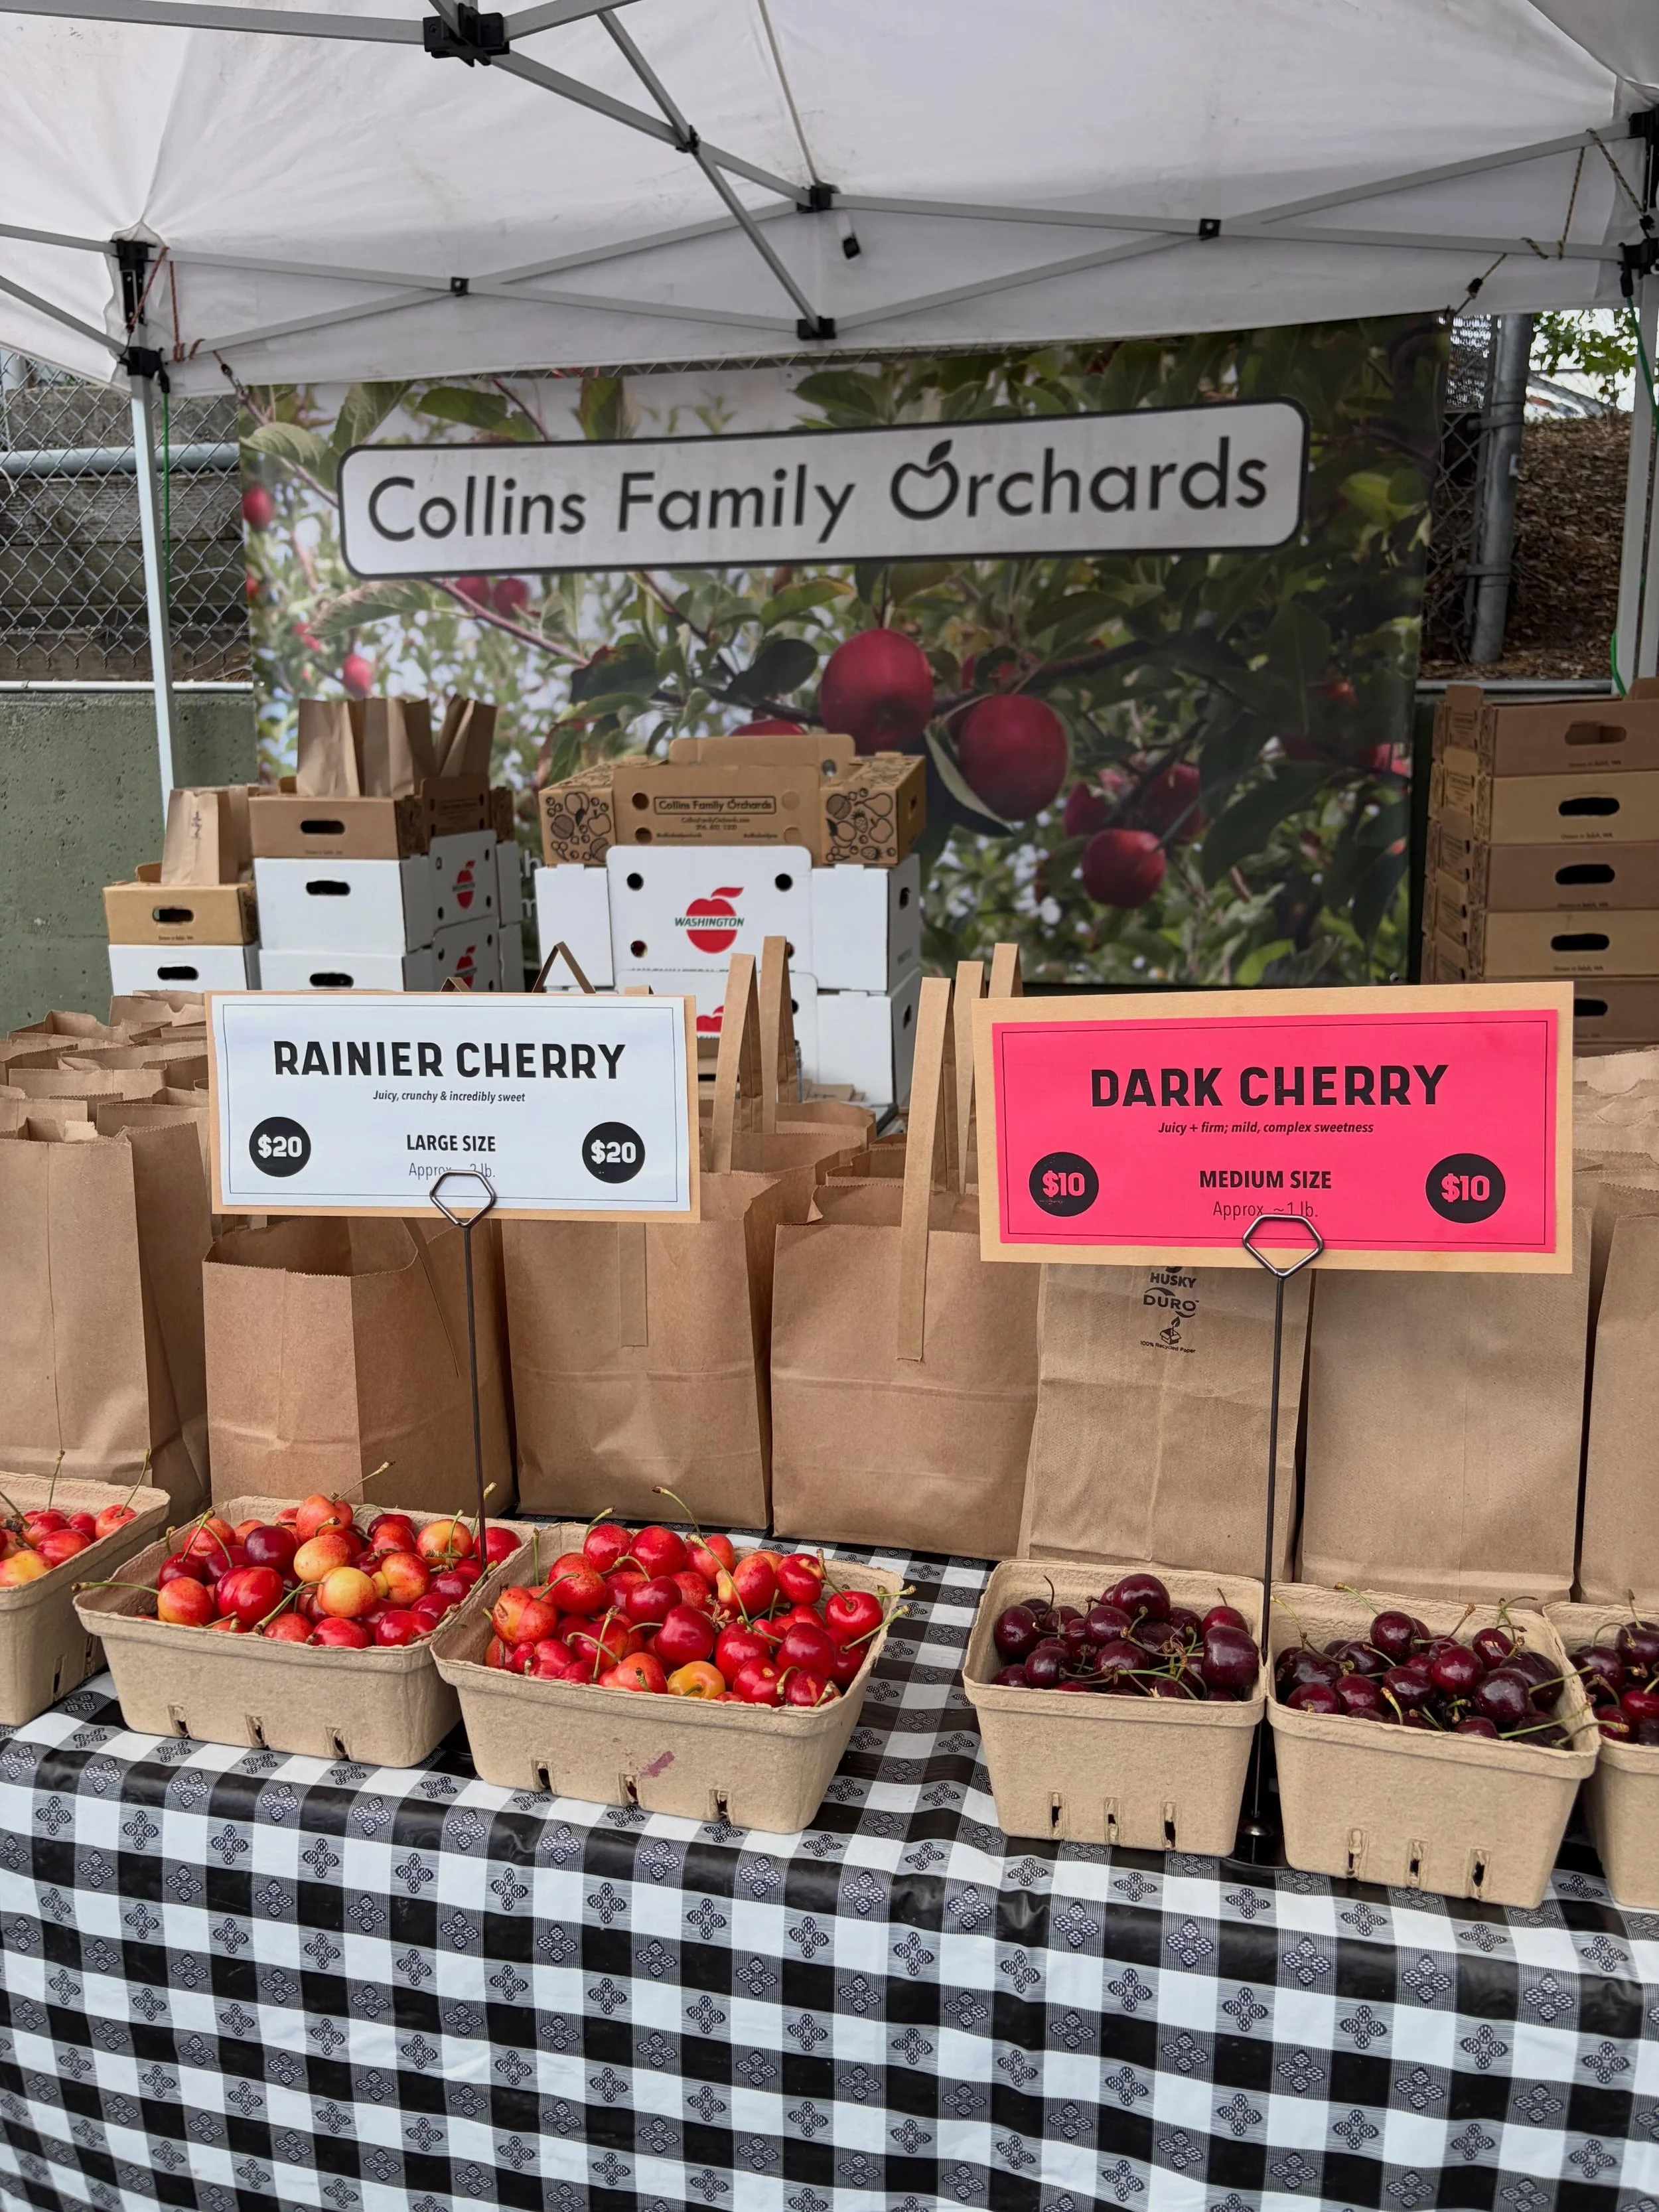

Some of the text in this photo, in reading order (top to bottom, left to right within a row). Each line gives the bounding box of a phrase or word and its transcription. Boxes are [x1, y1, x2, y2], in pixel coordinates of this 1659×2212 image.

[368, 435, 1267, 544] Collins Family Orchards
[659, 798, 772, 812] Collins Family Orchards
[674, 917, 745, 927] WASHINGTON
[274, 1041, 625, 1078] RAINIER CHERRY
[1092, 1065, 1449, 1106] DARK CHERRY
[373, 1090, 526, 1104] Juicy, crunchy & incredibly sweet
[1158, 1122, 1187, 1136] Juicy
[1201, 1122, 1228, 1134] firm;
[1231, 1122, 1260, 1134] mild,
[1263, 1122, 1311, 1135] complex
[1314, 1123, 1374, 1133] sweetness
[257, 1134, 303, 1159] $20
[407, 1134, 496, 1151] LARGE SIZE
[591, 1140, 636, 1164] $20
[481, 1163, 496, 1178] lb.
[1042, 1170, 1085, 1197] $10
[1200, 1170, 1331, 1189] MEDIUM SIZE
[1441, 1173, 1490, 1203] $10
[1301, 1201, 1318, 1217] lb.
[1150, 1272, 1197, 1288] HUSKY
[1155, 1342, 1179, 1352] Recycled
